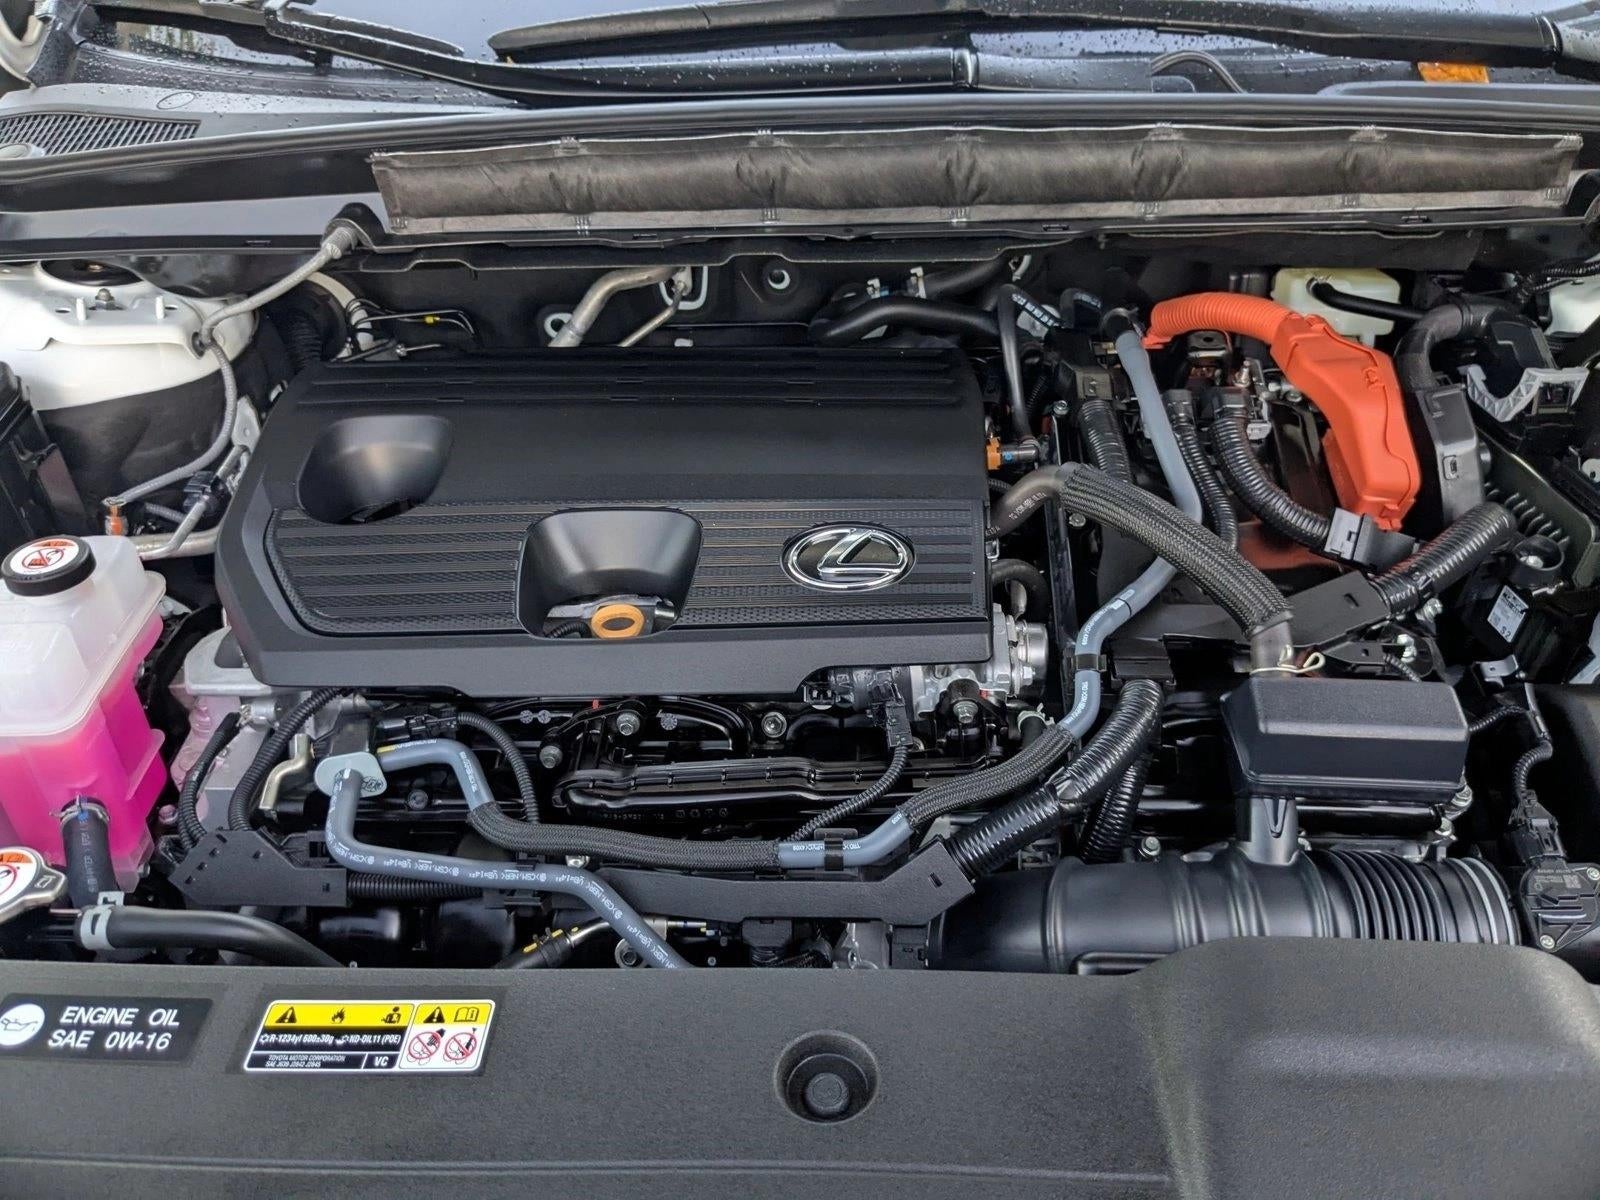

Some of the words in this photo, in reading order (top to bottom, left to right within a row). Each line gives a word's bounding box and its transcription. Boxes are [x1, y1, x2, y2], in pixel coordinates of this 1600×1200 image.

[59, 1006, 139, 1026] ENGINE
[148, 1008, 181, 1027] OIL
[48, 1029, 95, 1049] SAE
[104, 1031, 172, 1051] 0W-16
[269, 1033, 303, 1045] R-1234yf
[381, 1034, 402, 1045] (POE)
[374, 1056, 389, 1067] VC
